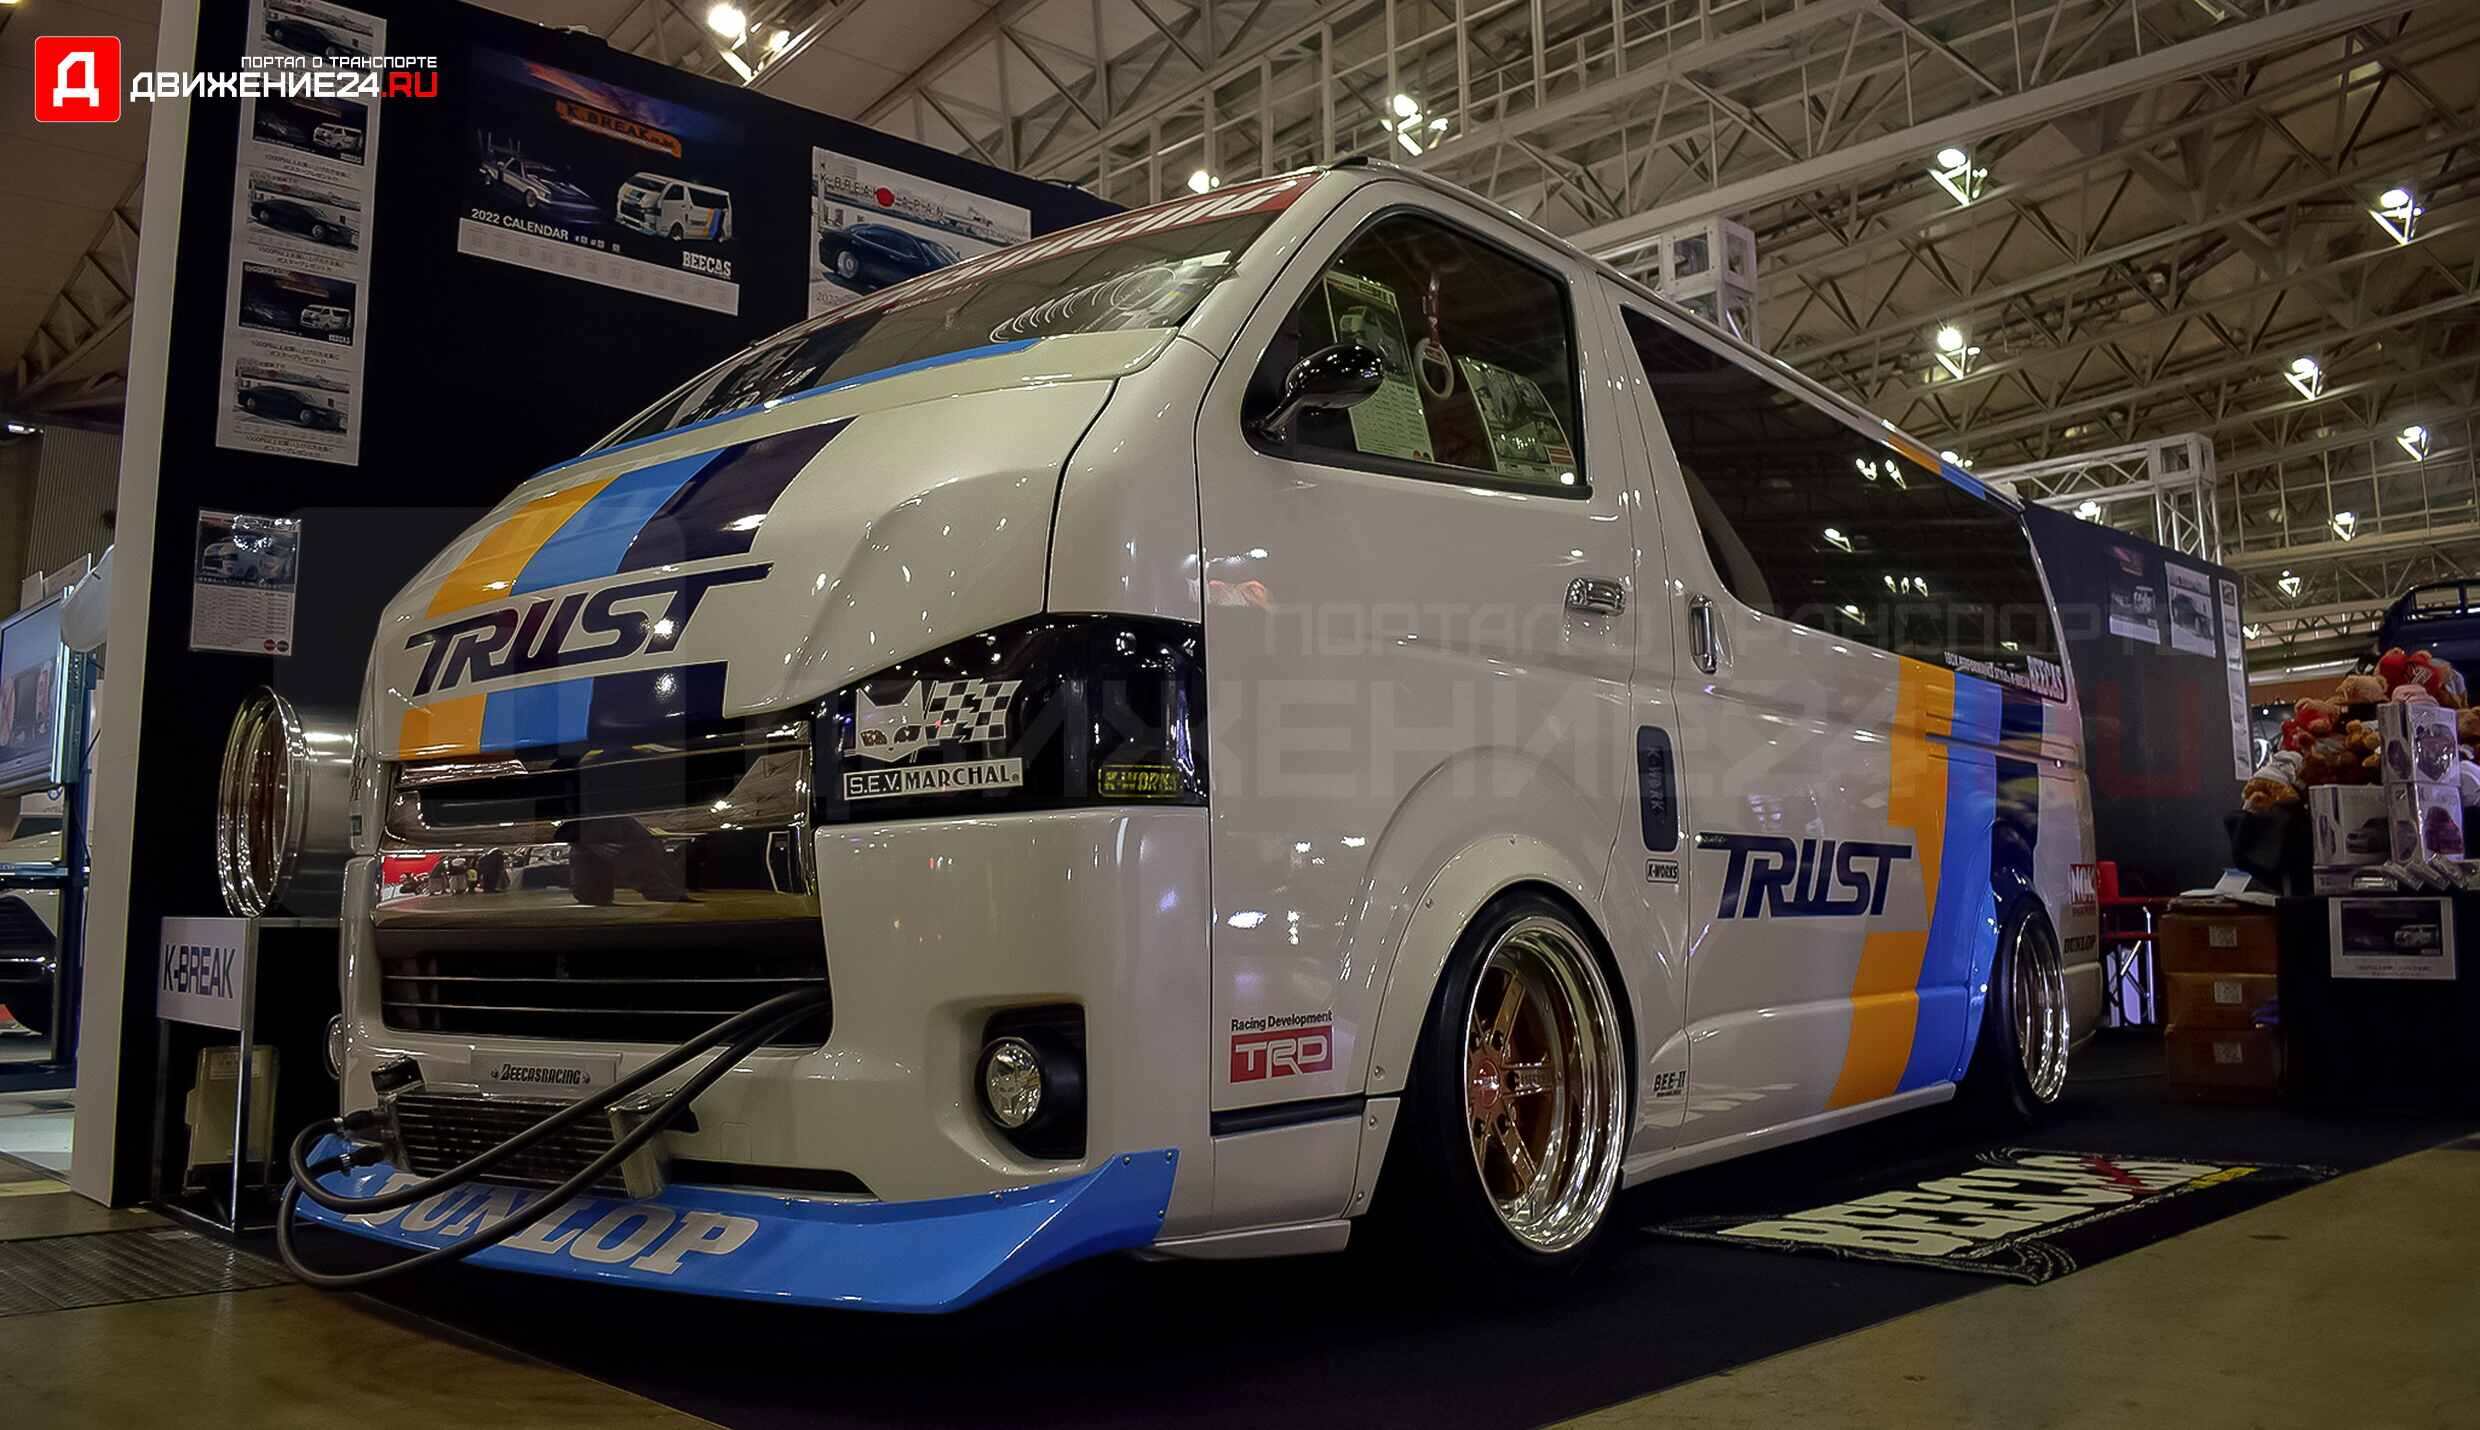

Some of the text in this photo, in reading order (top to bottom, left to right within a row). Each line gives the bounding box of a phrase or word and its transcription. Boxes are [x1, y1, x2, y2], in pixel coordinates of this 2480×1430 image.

[471, 208, 569, 241] 2022 CALENDAR
[682, 251, 732, 277] BEECAS
[404, 561, 776, 698] TRUST
[850, 764, 1010, 795] S.E.V. MARCHAL
[1697, 832, 1912, 919] TRUST
[163, 944, 236, 1000] K-BREAK
[1231, 1009, 1333, 1032] Racing Development
[1235, 1035, 1328, 1079] TRD
